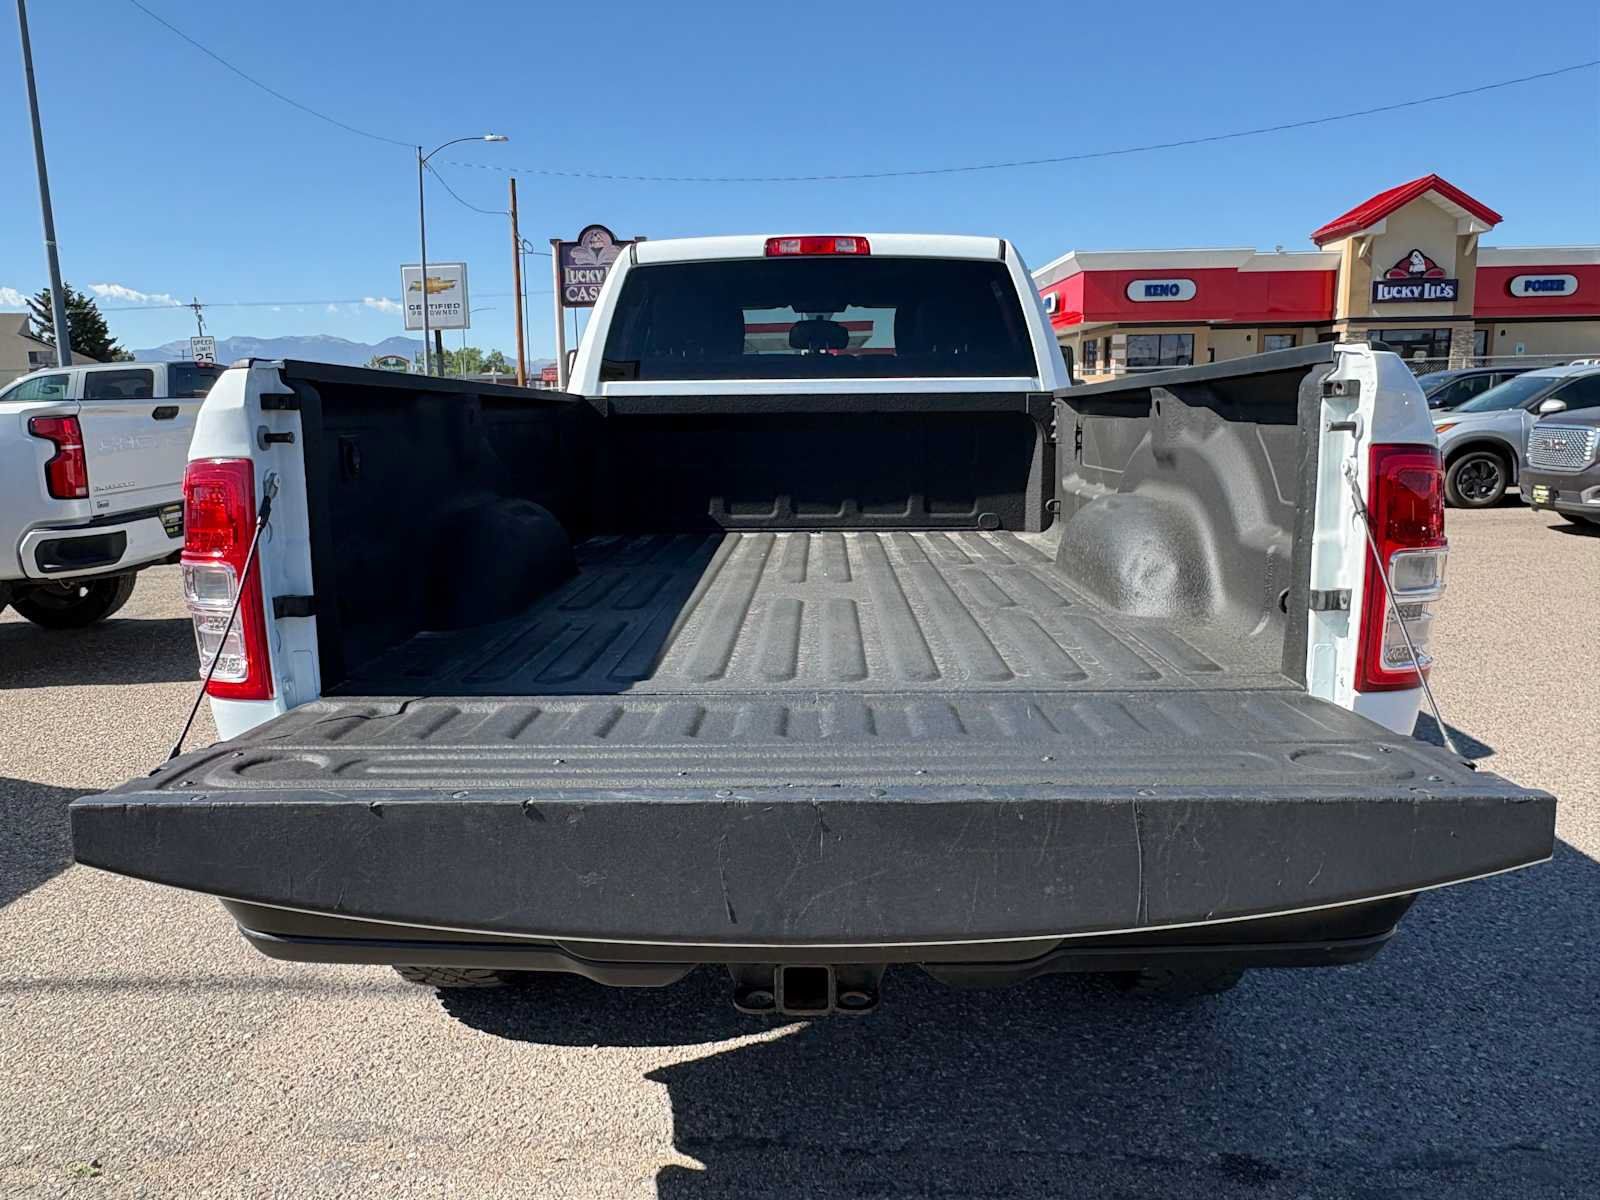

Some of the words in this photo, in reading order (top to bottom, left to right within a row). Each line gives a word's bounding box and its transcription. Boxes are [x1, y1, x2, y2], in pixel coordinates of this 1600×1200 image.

[565, 267, 604, 284] LUCKY
[566, 286, 602, 301] CAS
[1144, 283, 1180, 297] KENO
[1377, 284, 1422, 300] LUCKY
[1423, 282, 1454, 299] LIL'S
[409, 303, 461, 311] CETIFIED
[194, 352, 214, 363] 25
